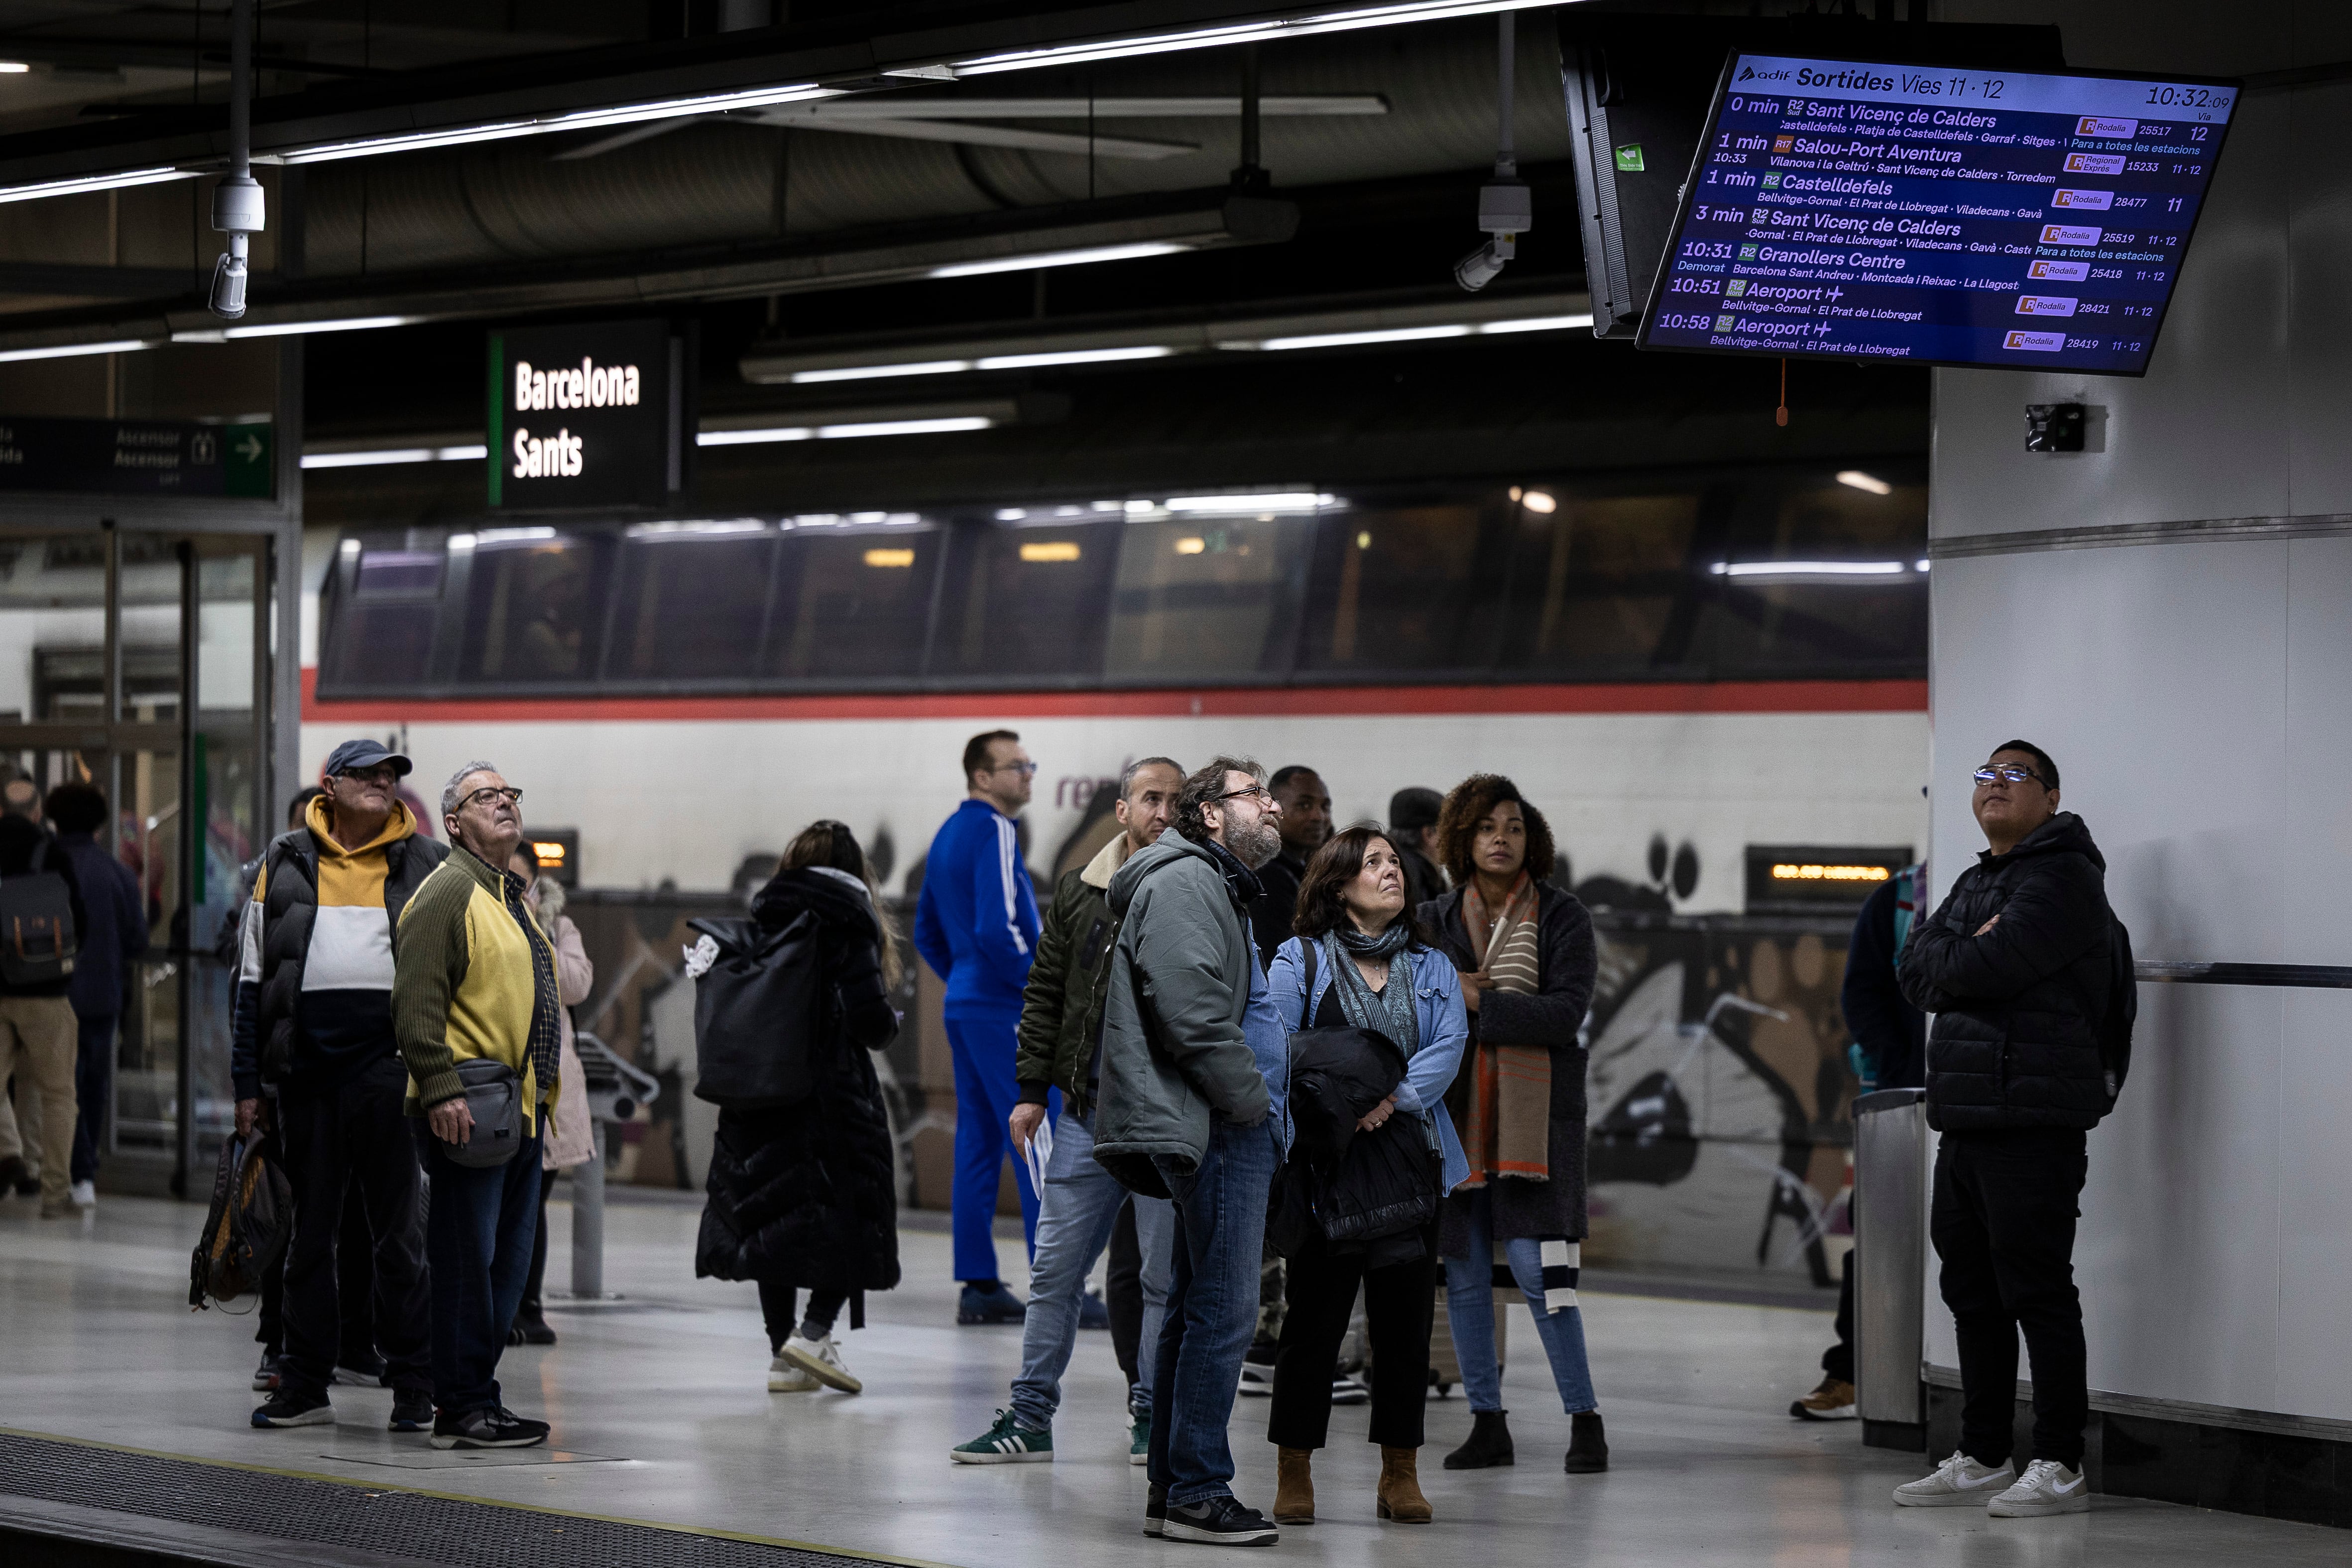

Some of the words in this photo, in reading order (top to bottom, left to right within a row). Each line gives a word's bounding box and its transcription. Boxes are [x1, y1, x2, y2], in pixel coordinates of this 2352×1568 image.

[1757, 69, 1792, 81] adif
[1796, 67, 1894, 91] Sortides
[1902, 74, 1942, 95] Vies
[1949, 77, 1967, 96] 11
[1983, 79, 2004, 99] 12
[1731, 97, 1743, 111] 0
[1748, 99, 1779, 114] min
[1787, 100, 1804, 110] R2
[1806, 102, 1845, 118] Sant
[1850, 105, 1904, 125] Vicenç
[1907, 109, 1929, 123] de
[1933, 110, 1997, 127] Calders
[2198, 112, 2211, 121] Via
[2097, 123, 2126, 132] Rodalia
[2139, 125, 2171, 135] 25517
[2191, 126, 2208, 141] 12
[1719, 133, 1729, 147] 1
[1736, 135, 1767, 150] min
[1854, 124, 1885, 137] Platja
[1887, 126, 1901, 136] de
[1903, 128, 1973, 141] Castelldefels
[1981, 132, 2016, 143] Garraf
[2022, 135, 2055, 147] Sitges
[1775, 139, 1791, 148] R17
[2071, 138, 2094, 148] Para
[2105, 141, 2132, 151] totes
[2134, 142, 2149, 152] les
[2151, 144, 2200, 155] estacions
[1794, 138, 1885, 158] Salou-Port
[1886, 144, 1962, 162] Aventura
[1713, 152, 1747, 163] 10:33
[2086, 156, 2120, 165] Regional
[1770, 156, 1815, 168] Vilanova
[1817, 159, 1821, 168] i
[1822, 159, 1833, 169] la
[1835, 161, 1869, 171] Geltrú
[1877, 163, 1901, 173] Sant
[1904, 165, 1939, 178] Vicenç
[1941, 167, 1955, 177] de
[1957, 168, 1998, 180] Calders
[2007, 171, 2056, 183] Torredem
[2083, 163, 2110, 173] Exprés
[2126, 161, 2159, 171] 15233
[2173, 164, 2182, 173] 11
[2190, 165, 2201, 174] 12
[1707, 169, 1718, 184] 1
[1724, 171, 1756, 186] min
[1763, 175, 1779, 185] R2
[1783, 175, 1892, 195] Castelldefels
[1757, 192, 1842, 206] Bellvitge-Gornal
[1849, 198, 1860, 207] El
[1861, 199, 1883, 209] Prat
[1884, 200, 1897, 210] de
[1899, 201, 1949, 214] Llobregat
[1957, 205, 2009, 216] Viladecans
[2017, 209, 2042, 218] Gavà
[2073, 195, 2102, 204] Rodalia
[2115, 197, 2147, 207] 28477
[2168, 198, 2182, 212] 11
[1696, 206, 1709, 220] 3
[1712, 208, 1744, 222] min
[1752, 208, 1768, 219] R2
[1770, 211, 1810, 227] Sant
[1815, 213, 1869, 234] Vicenç
[1872, 217, 1893, 232] de
[1897, 219, 1961, 236] Calders
[1792, 231, 1804, 241] El
[1805, 232, 1828, 242] Prat
[1830, 234, 1844, 243] de
[1845, 235, 1898, 248] Llobregat
[1906, 238, 1962, 250] Viladecans
[1970, 242, 1996, 252] Gavà
[2102, 233, 2134, 243] 25519
[2148, 235, 2158, 244] 11
[2166, 237, 2177, 245] 12
[1682, 241, 1732, 258] 10:31
[1739, 247, 1756, 257] R2
[2035, 245, 2058, 256] Para
[2069, 248, 2096, 258] totes
[2098, 249, 2113, 259] les
[2115, 251, 2164, 261] estacions
[1759, 247, 1845, 265] Granollers
[1849, 252, 1905, 269] Centre
[1677, 260, 1725, 272] Demorat
[2048, 266, 2078, 275] Rodalia
[1733, 264, 1786, 276] Barcelona
[1788, 267, 1814, 278] Sant
[1814, 269, 1854, 280] Andreu
[1861, 272, 1914, 284] Montcada
[1915, 275, 1920, 284] i
[1921, 275, 1956, 286] Reixac
[1964, 278, 1977, 287] La
[1979, 279, 2019, 291] Llagost
[2090, 268, 2122, 278] 25418
[2136, 271, 2146, 280] 11
[2154, 272, 2164, 281] 12
[1671, 277, 1720, 294] 10:51
[1729, 280, 1746, 291] R2
[1746, 282, 1823, 302] Aeroport
[1722, 300, 1811, 314] Bellvitge-Gornal
[1818, 306, 1829, 315] El
[1831, 306, 1853, 316] Prat
[1855, 308, 1869, 317] de
[1871, 309, 1922, 321] Llobregat
[2036, 302, 2066, 310] Rodalia
[2078, 304, 2109, 313] 28421
[2124, 306, 2134, 315] 11
[2141, 307, 2152, 316] 12
[1659, 314, 1710, 330] 10:58
[1717, 316, 1733, 326] R2
[1734, 318, 1810, 337] Aeroport
[1710, 335, 1799, 349] Bellvitge-Gornal
[1806, 341, 1817, 350] El
[1819, 342, 1841, 352] Prat
[1843, 343, 1857, 352] de
[1859, 344, 1910, 357] Llobregat
[2066, 339, 2099, 349] 28419
[2113, 341, 2122, 350] 11
[2129, 342, 2140, 351] 12
[515, 356, 640, 411] Barcelona
[512, 427, 583, 479] Sants
